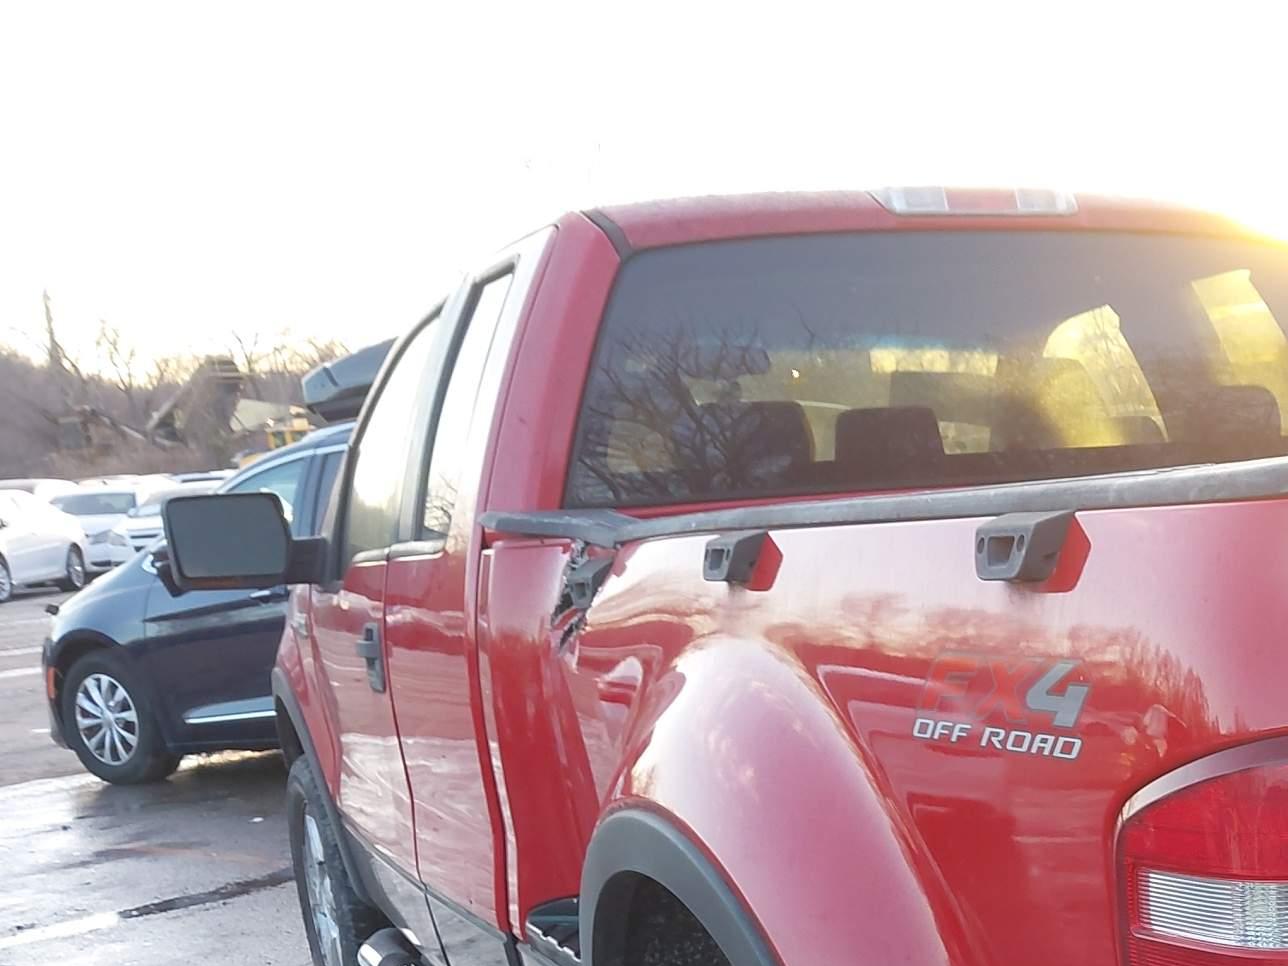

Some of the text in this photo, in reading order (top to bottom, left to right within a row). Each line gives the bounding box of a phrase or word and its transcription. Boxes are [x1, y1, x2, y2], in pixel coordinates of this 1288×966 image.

[920, 655, 1090, 728] FX4
[912, 718, 1083, 760] OFF ROAD
